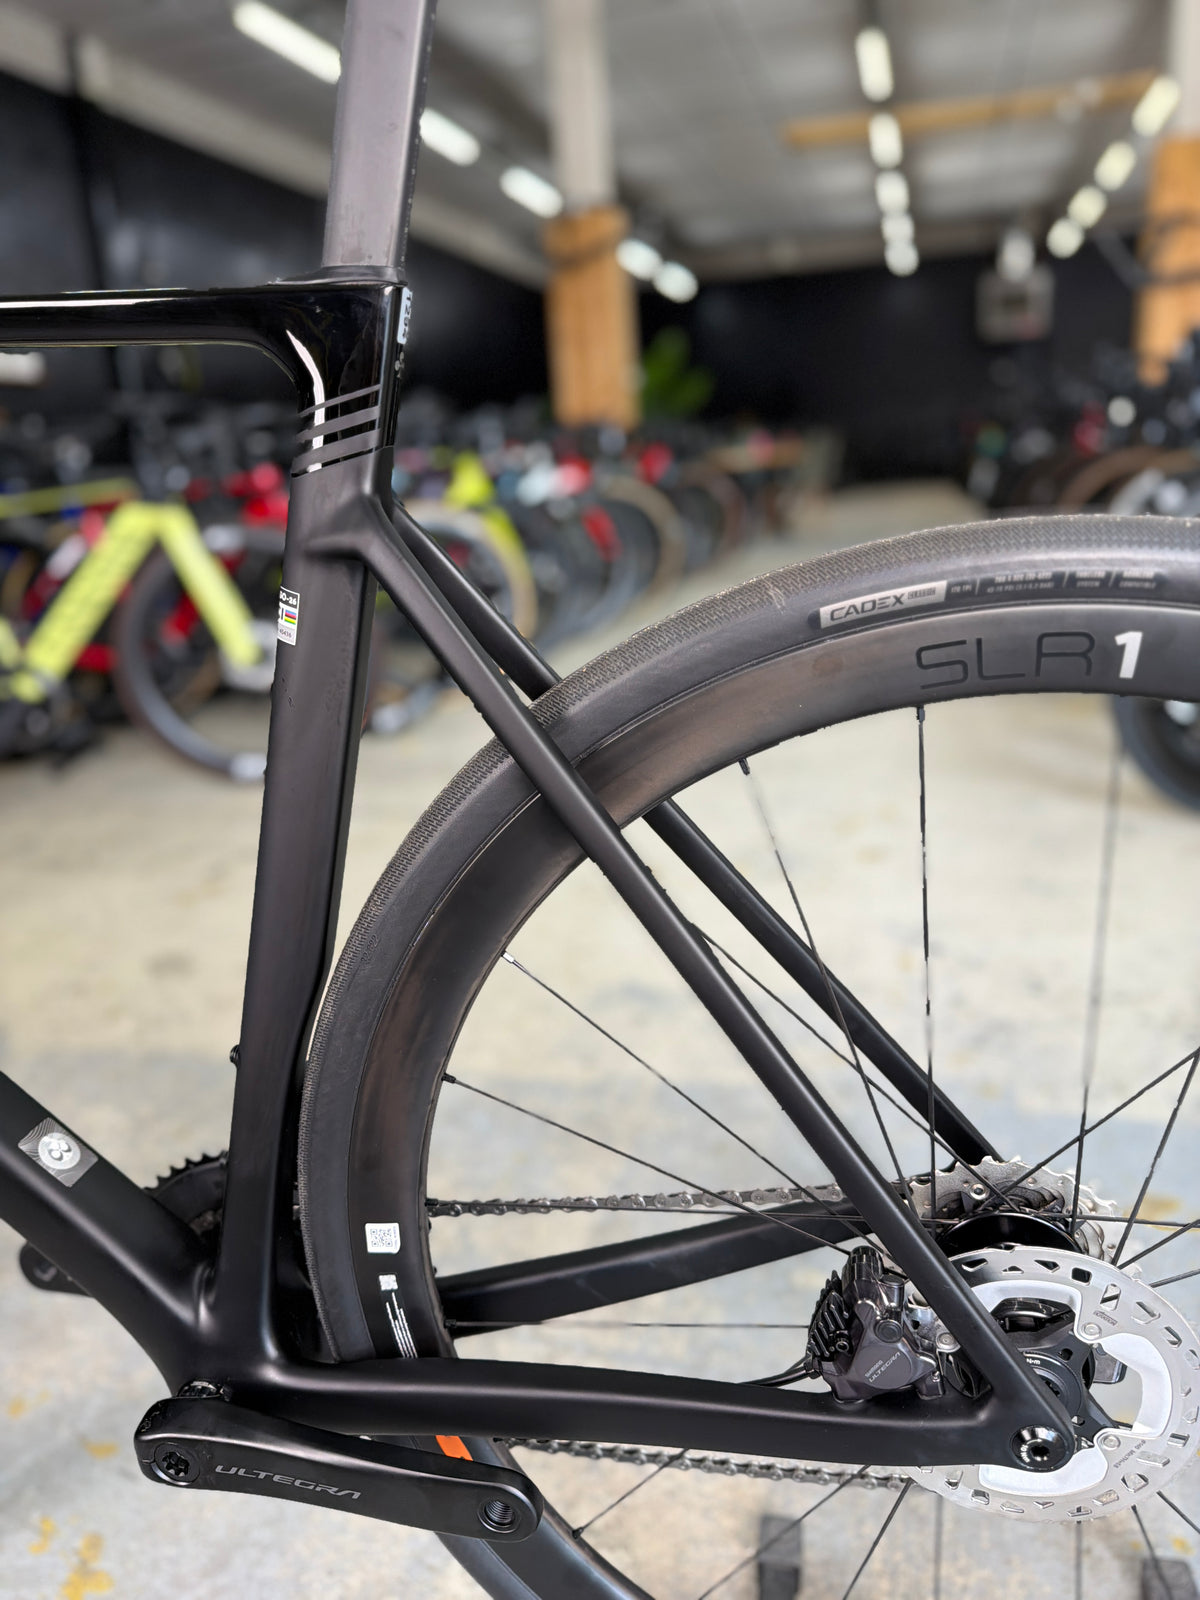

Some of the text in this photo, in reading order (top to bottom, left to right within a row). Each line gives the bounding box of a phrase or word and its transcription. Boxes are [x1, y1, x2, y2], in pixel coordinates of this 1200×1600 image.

[830, 593, 905, 622] CADEX
[915, 631, 1143, 690] SLR 1
[869, 1351, 901, 1383] ULTEGRA
[215, 1465, 361, 1500] ULTEGRA
